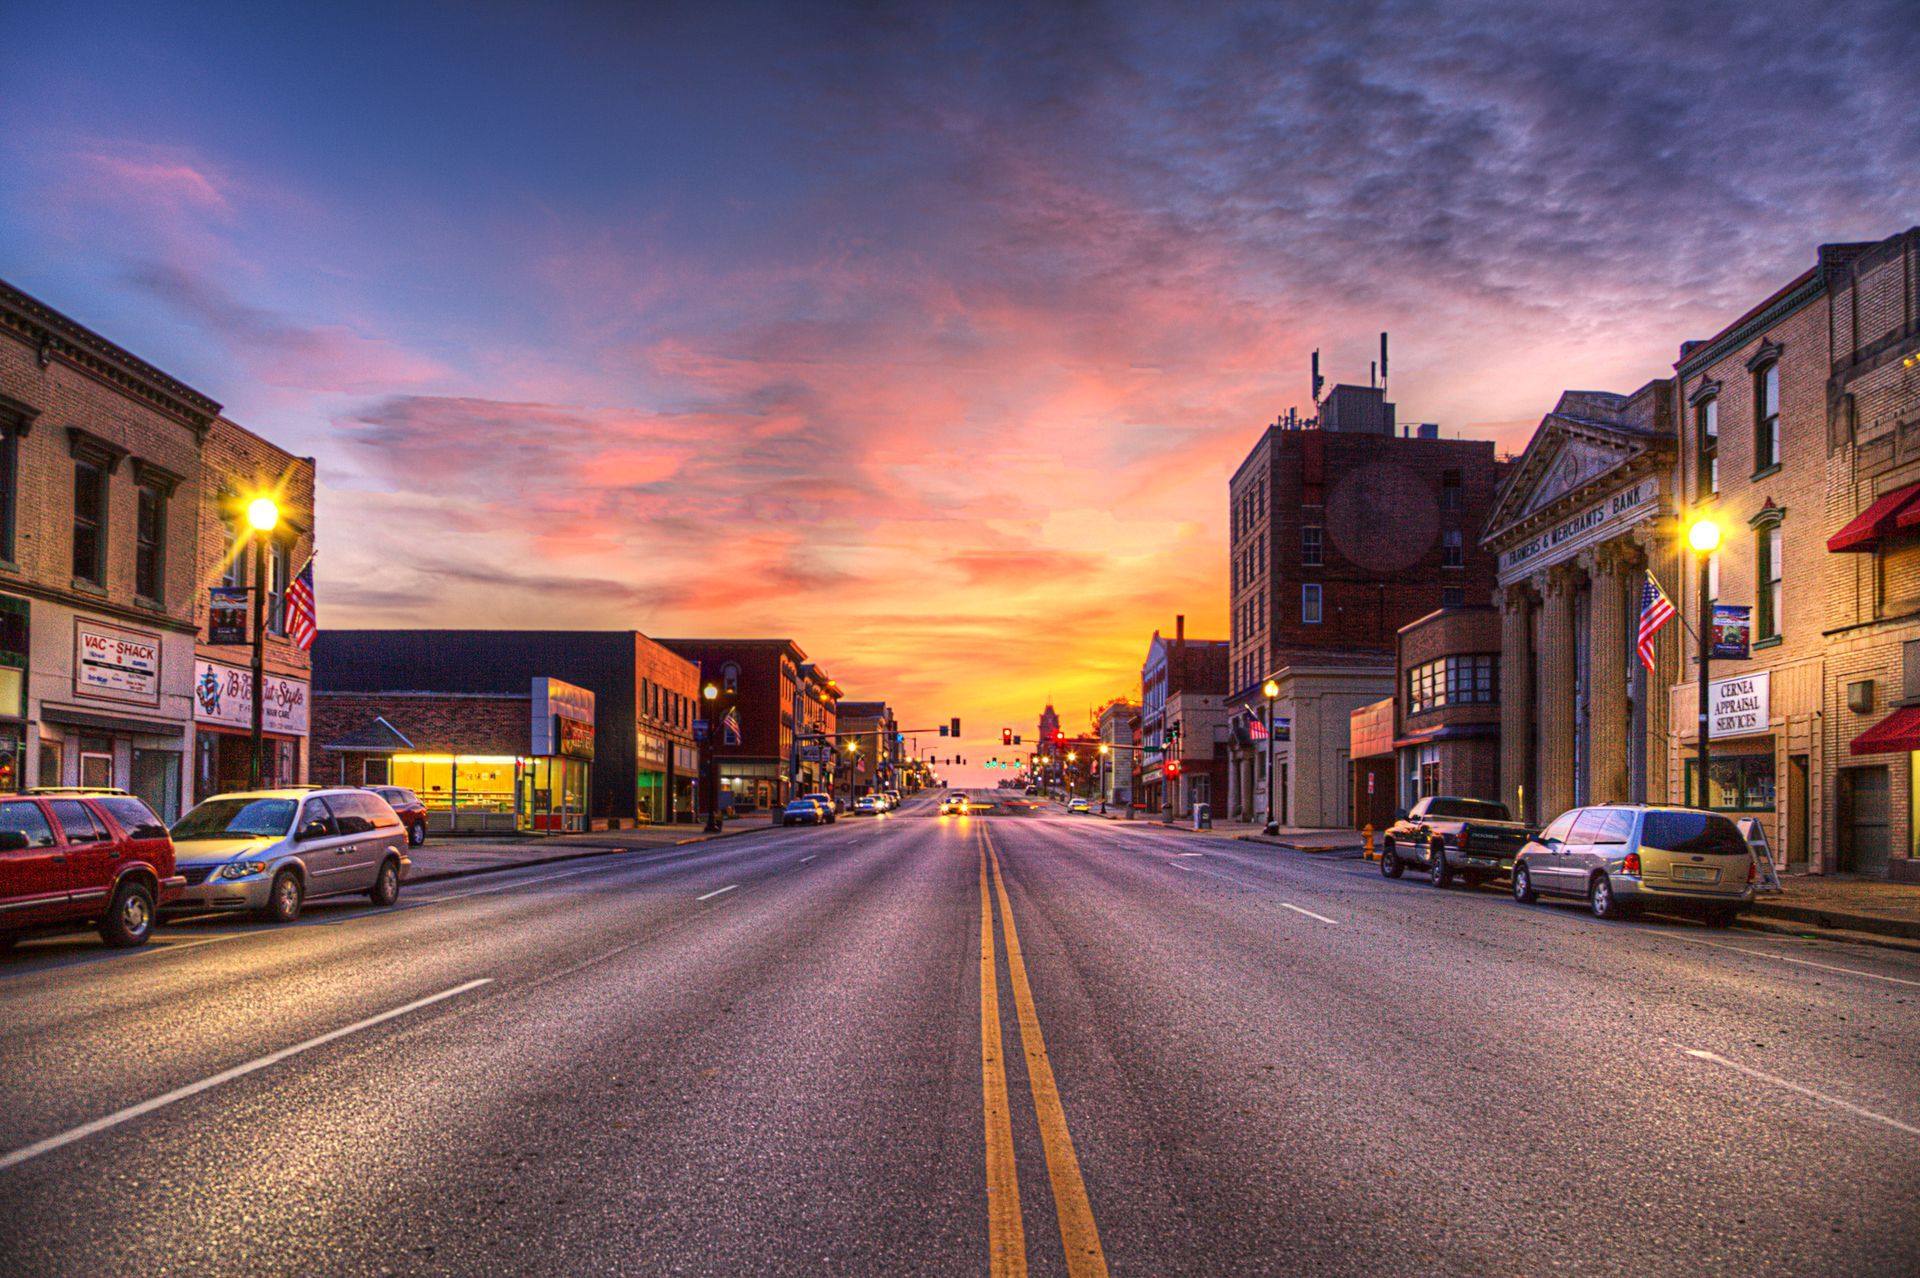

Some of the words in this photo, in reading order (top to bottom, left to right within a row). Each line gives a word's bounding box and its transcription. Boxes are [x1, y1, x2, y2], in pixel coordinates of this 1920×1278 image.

[1508, 538, 1541, 566] FARMERS
[1543, 534, 1549, 548] &
[1552, 504, 1604, 545] MERCHANTS
[1612, 485, 1641, 514] BANK
[84, 634, 107, 651] VAC
[116, 641, 154, 661] SHACK
[277, 681, 304, 712] Style
[1720, 680, 1754, 698] CERNEA
[278, 709, 291, 720] CARE
[1714, 695, 1760, 716] APPRAISAL
[1716, 712, 1757, 731] SERVICES
